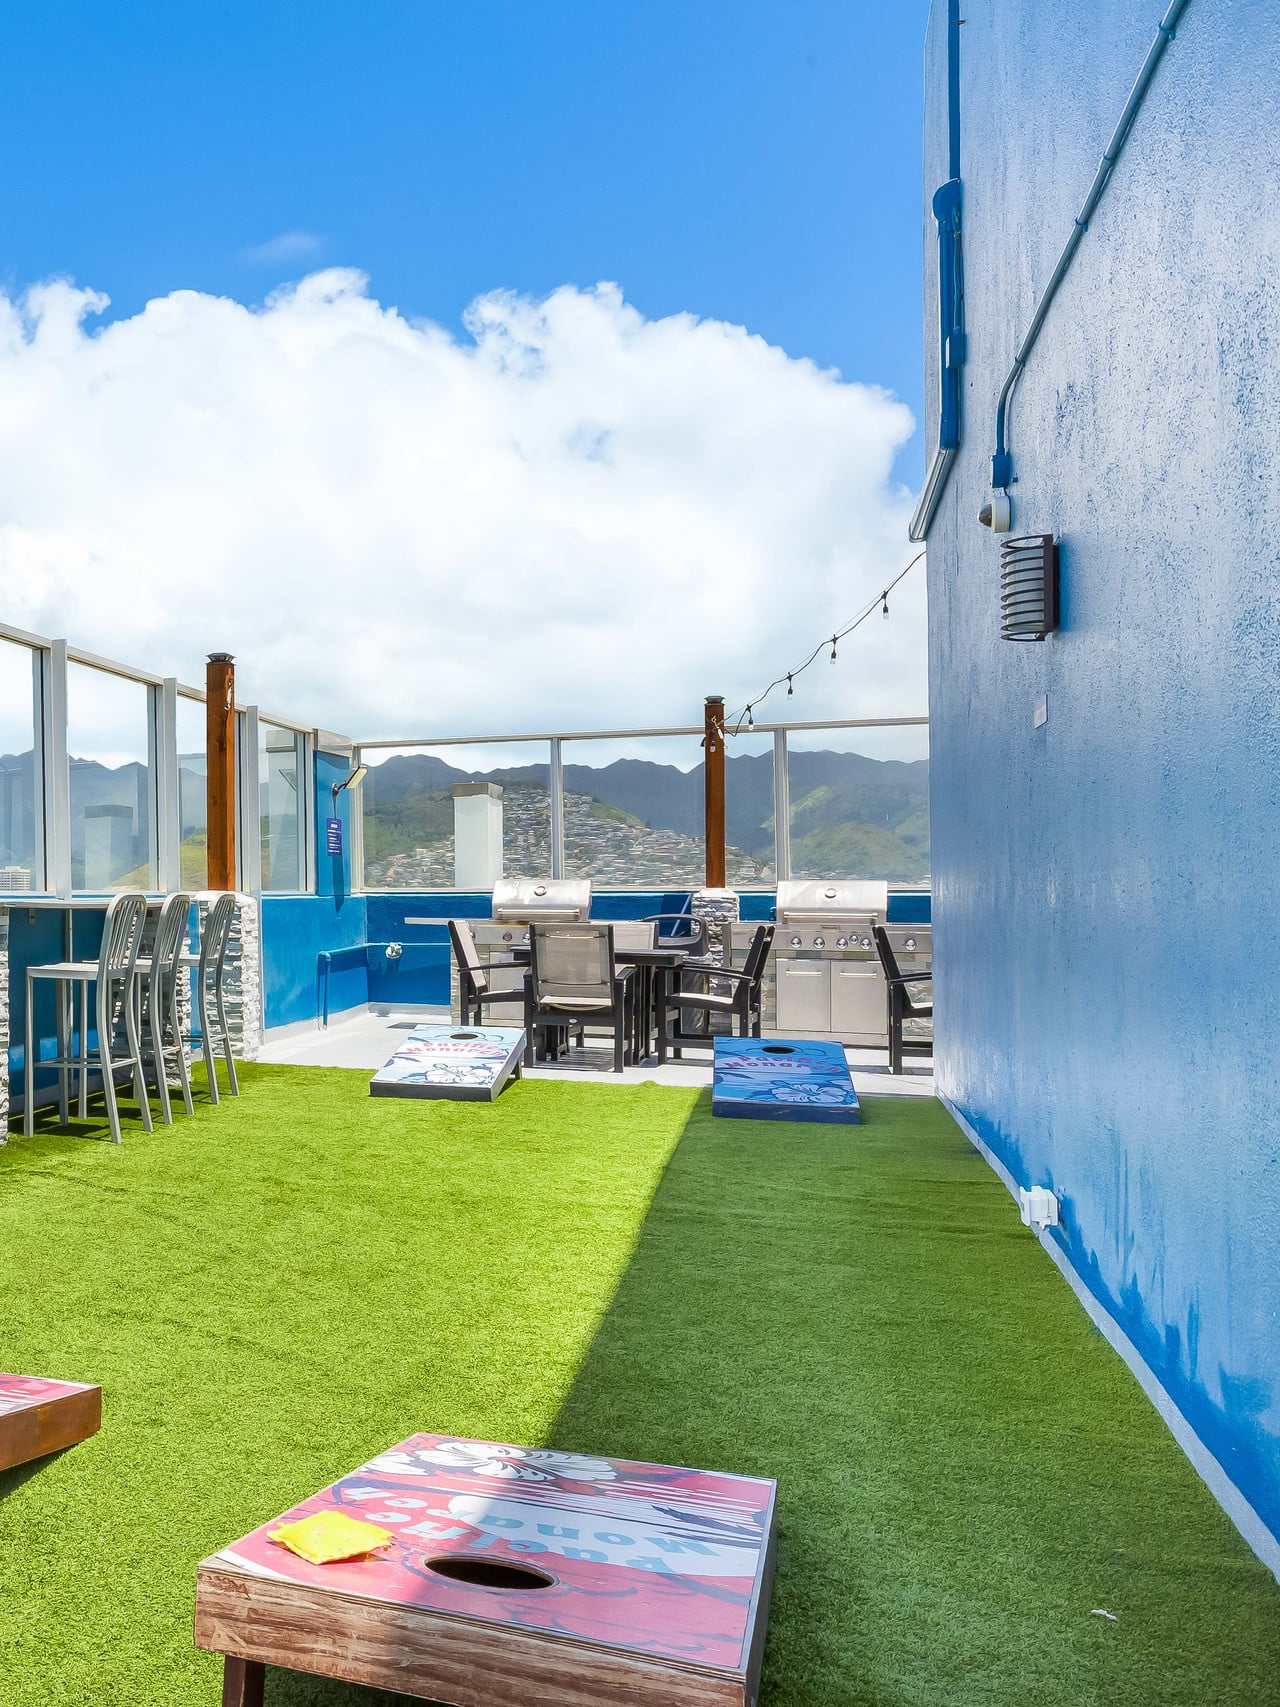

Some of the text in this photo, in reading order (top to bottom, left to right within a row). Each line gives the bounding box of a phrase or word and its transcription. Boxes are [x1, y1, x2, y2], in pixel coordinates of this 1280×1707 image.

[723, 1061, 840, 1073] Monarch
[737, 1055, 827, 1065] Pacific
[343, 1485, 721, 1557] Monarch
[364, 1511, 678, 1575] Pacific
